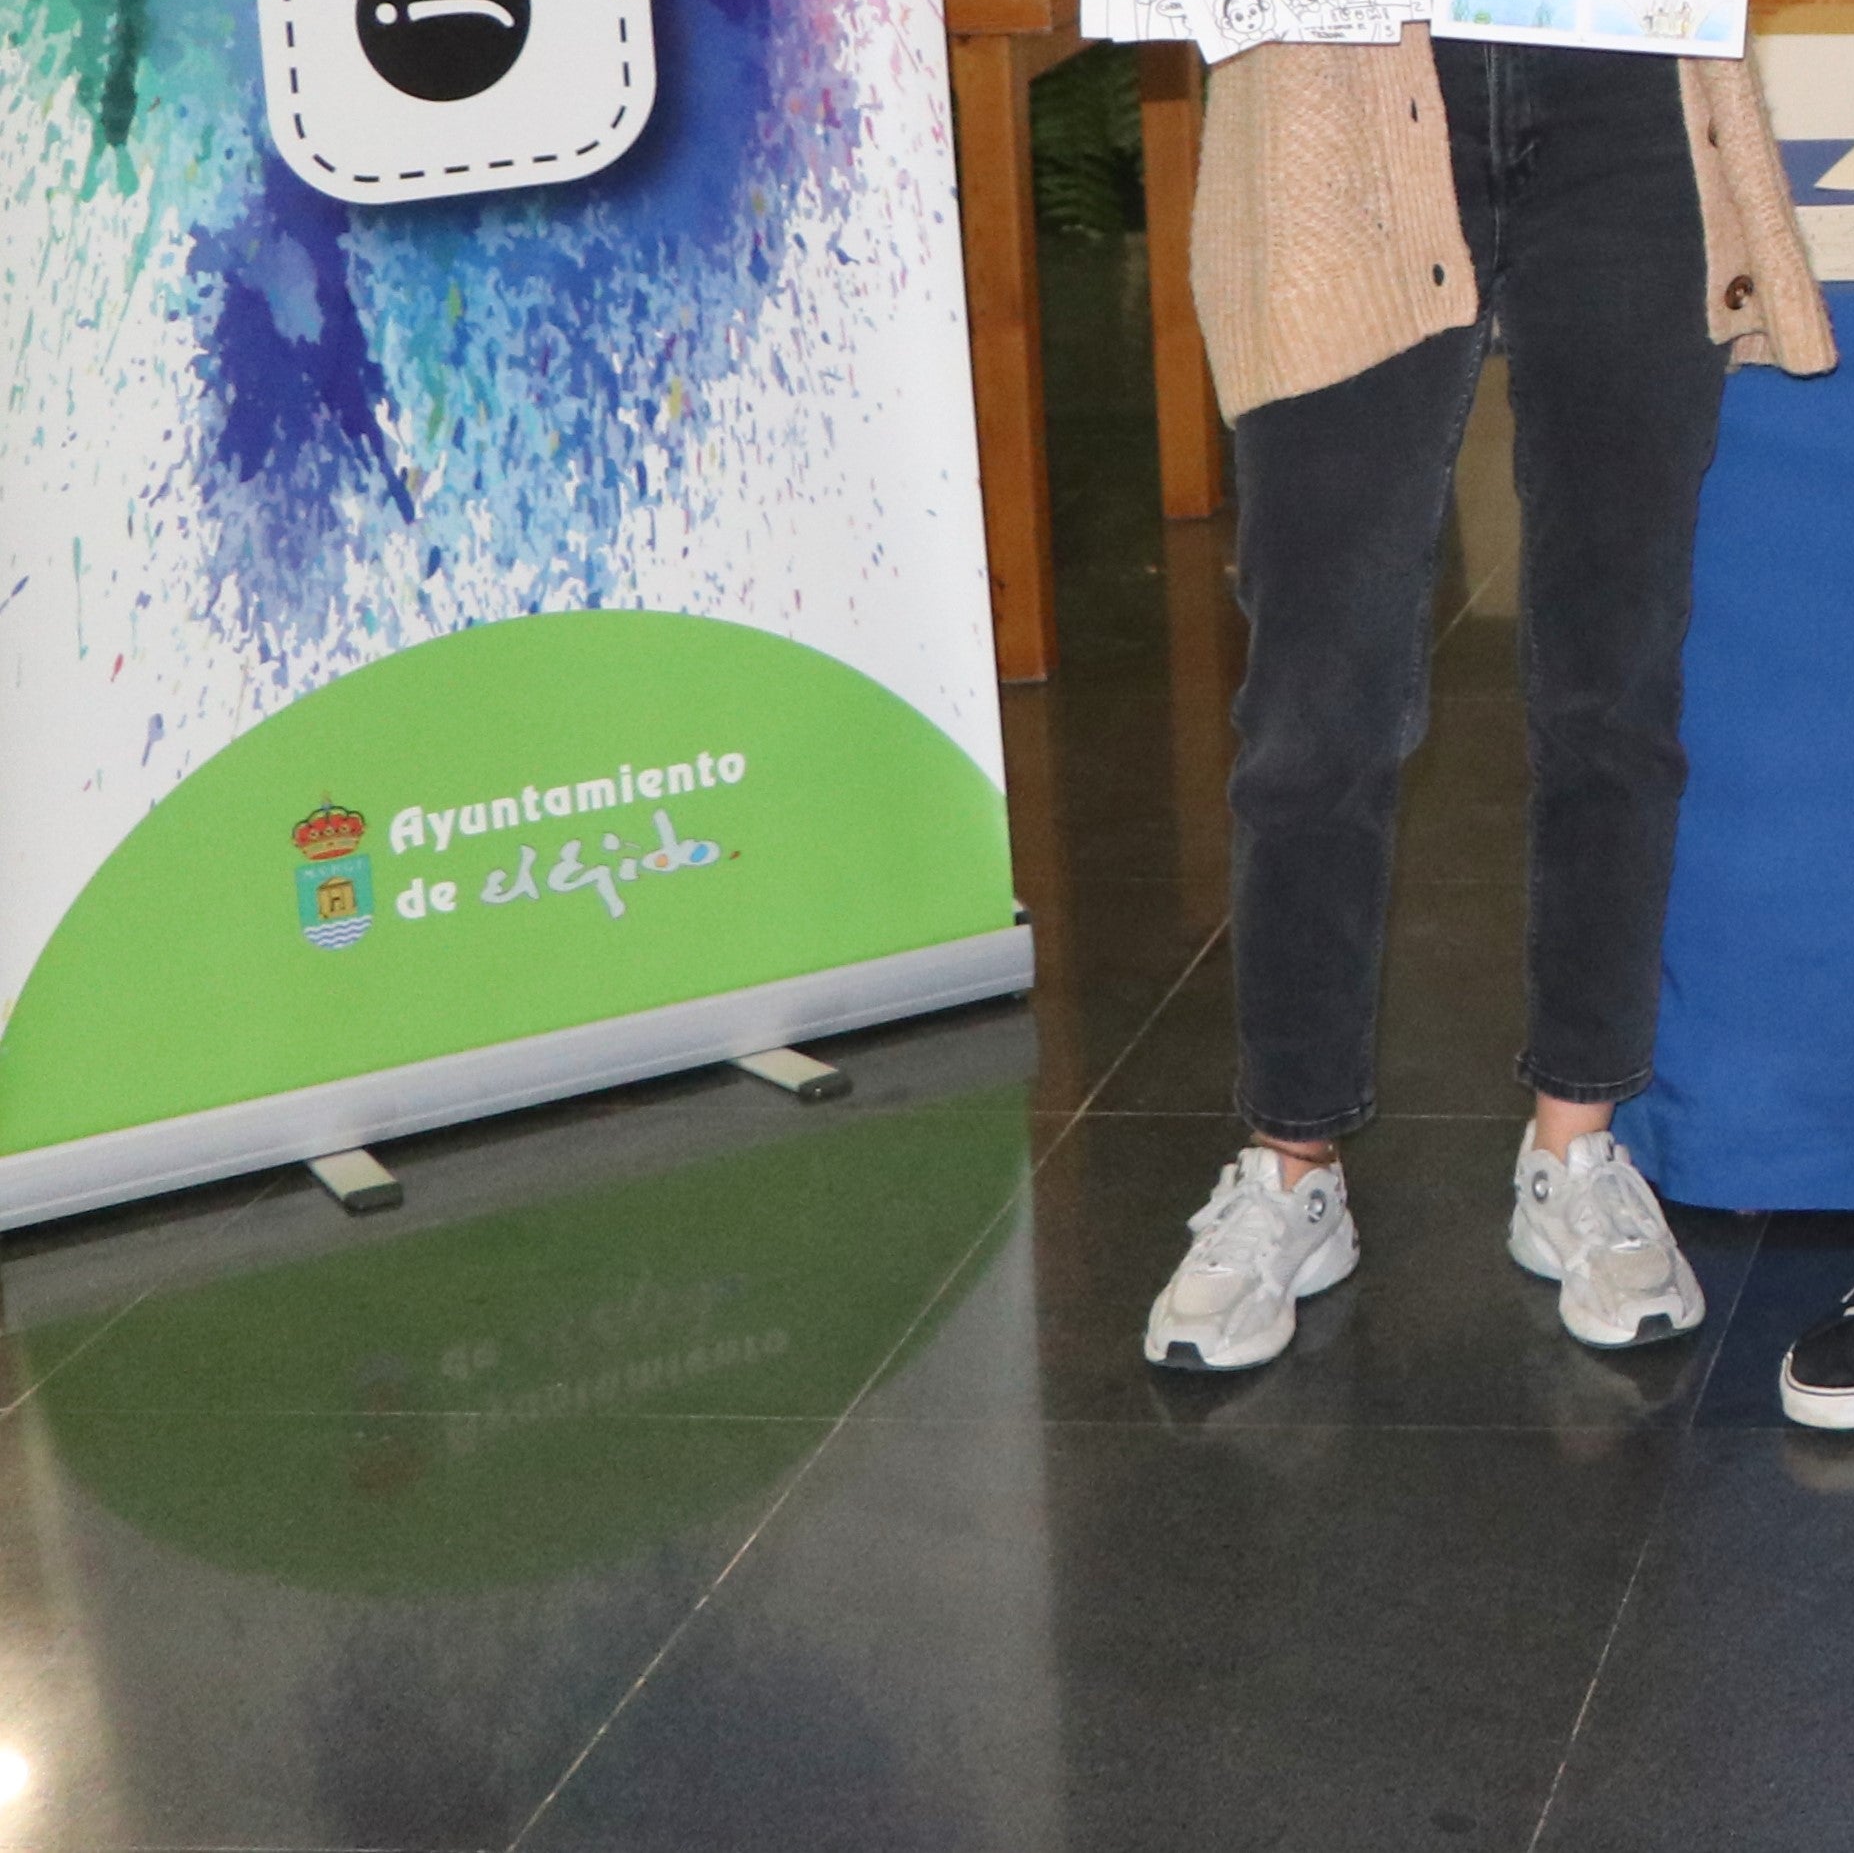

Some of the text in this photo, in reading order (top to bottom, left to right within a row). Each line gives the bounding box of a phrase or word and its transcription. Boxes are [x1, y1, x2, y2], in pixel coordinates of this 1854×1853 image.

[389, 750, 748, 855] Ayuntamiento
[397, 877, 457, 920] de
[480, 845, 539, 906] el
